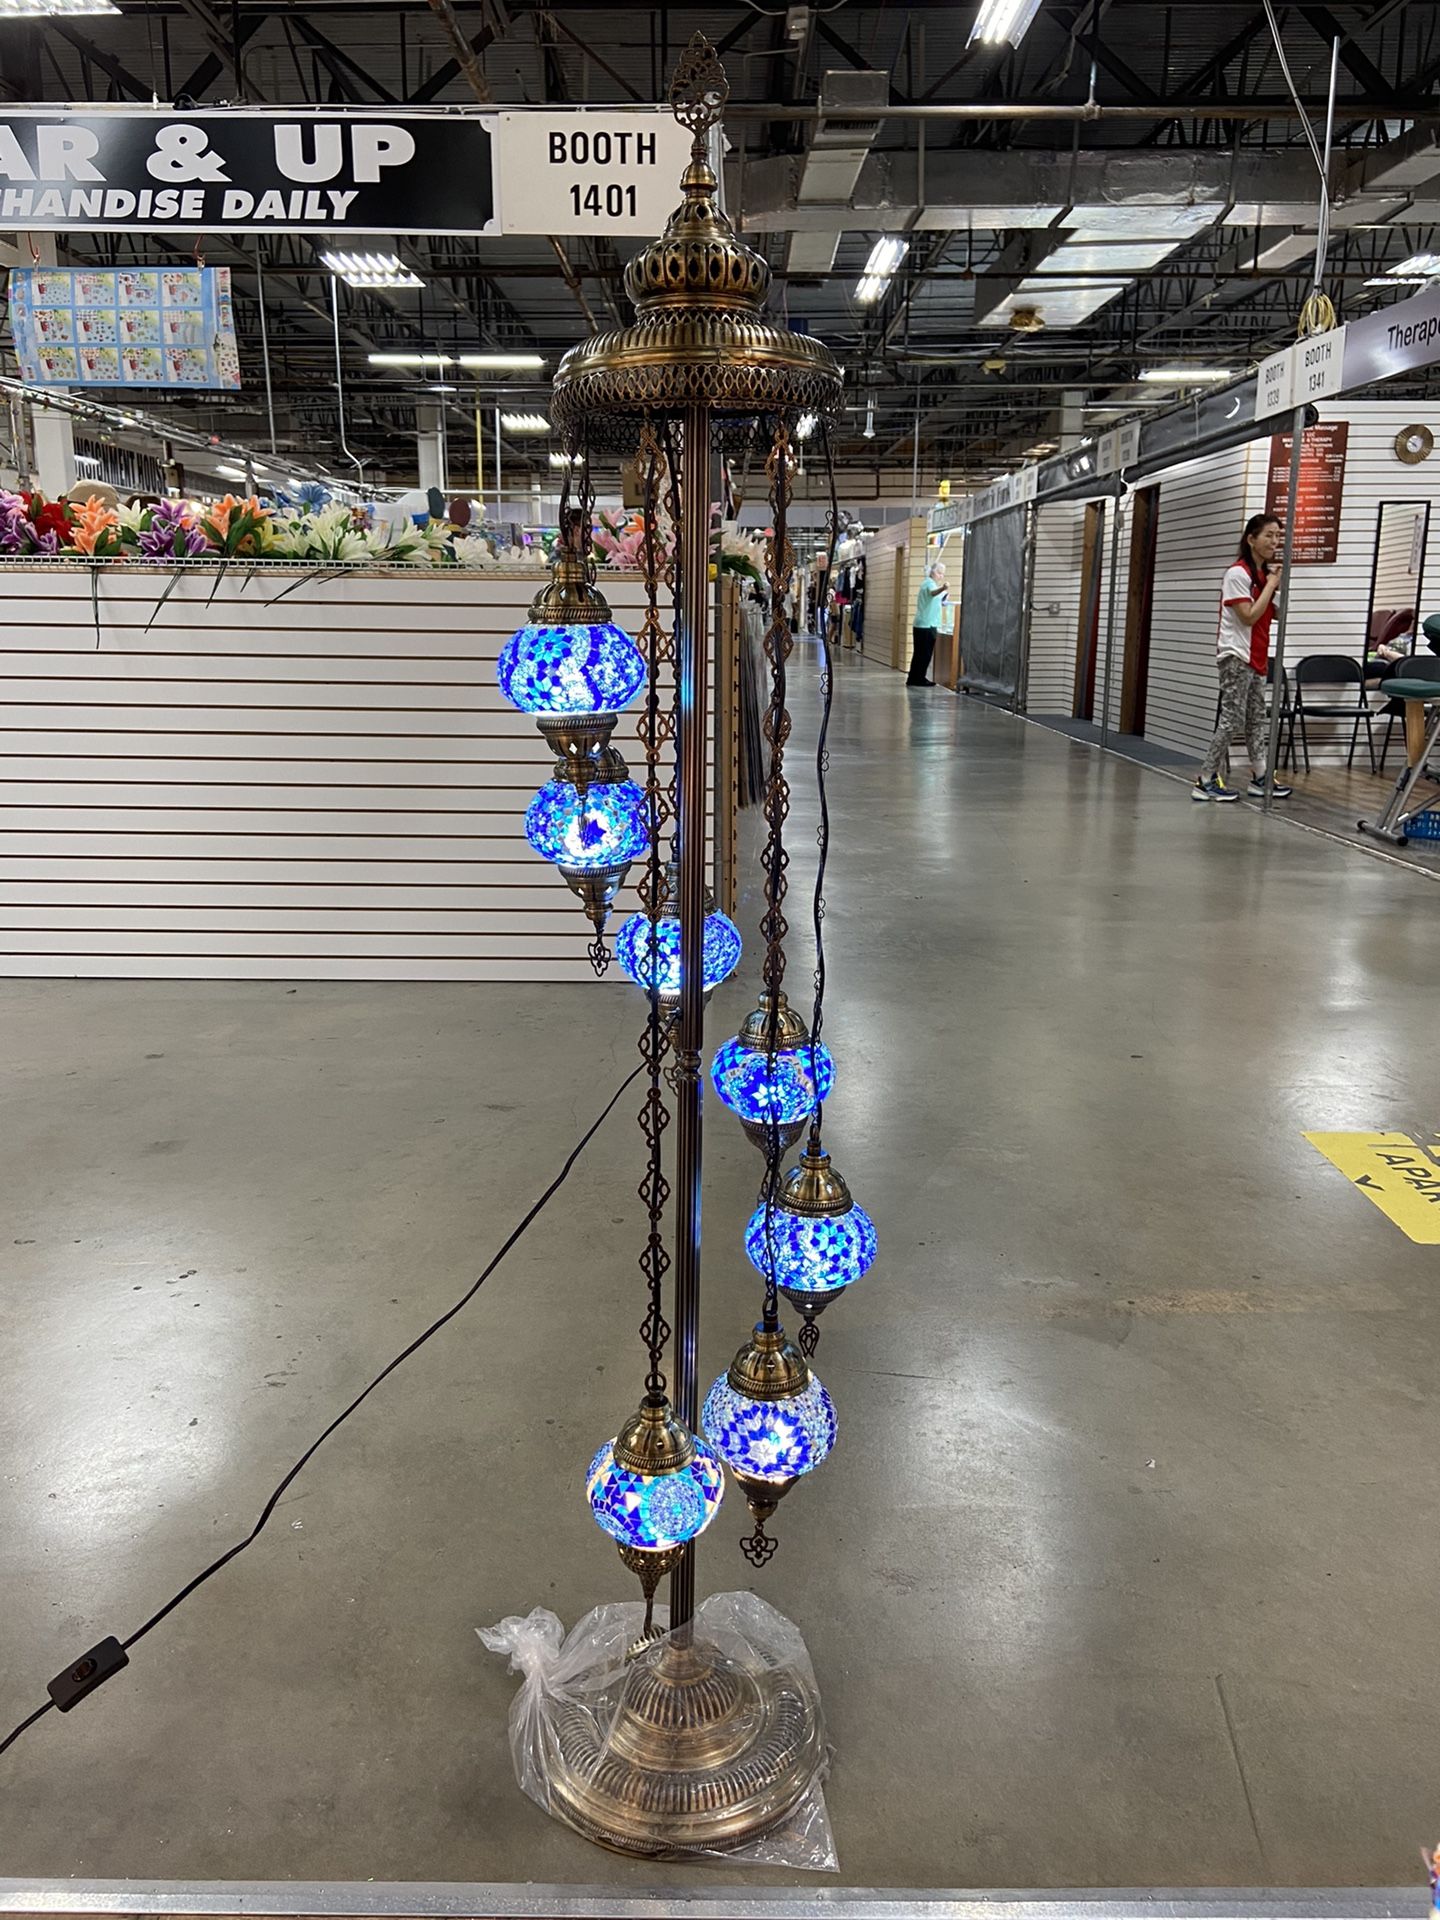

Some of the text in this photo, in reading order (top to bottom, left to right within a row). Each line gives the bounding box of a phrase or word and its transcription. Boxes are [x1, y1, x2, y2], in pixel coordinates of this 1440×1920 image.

[146, 123, 233, 183] &
[274, 124, 416, 183] UP
[549, 131, 656, 165] BOOTH
[0, 188, 360, 220] HANDISE DAILY
[570, 184, 636, 217] 1401
[1387, 317, 1440, 350] Therap
[1305, 341, 1332, 367] BOOTH
[1309, 371, 1325, 392] 1341
